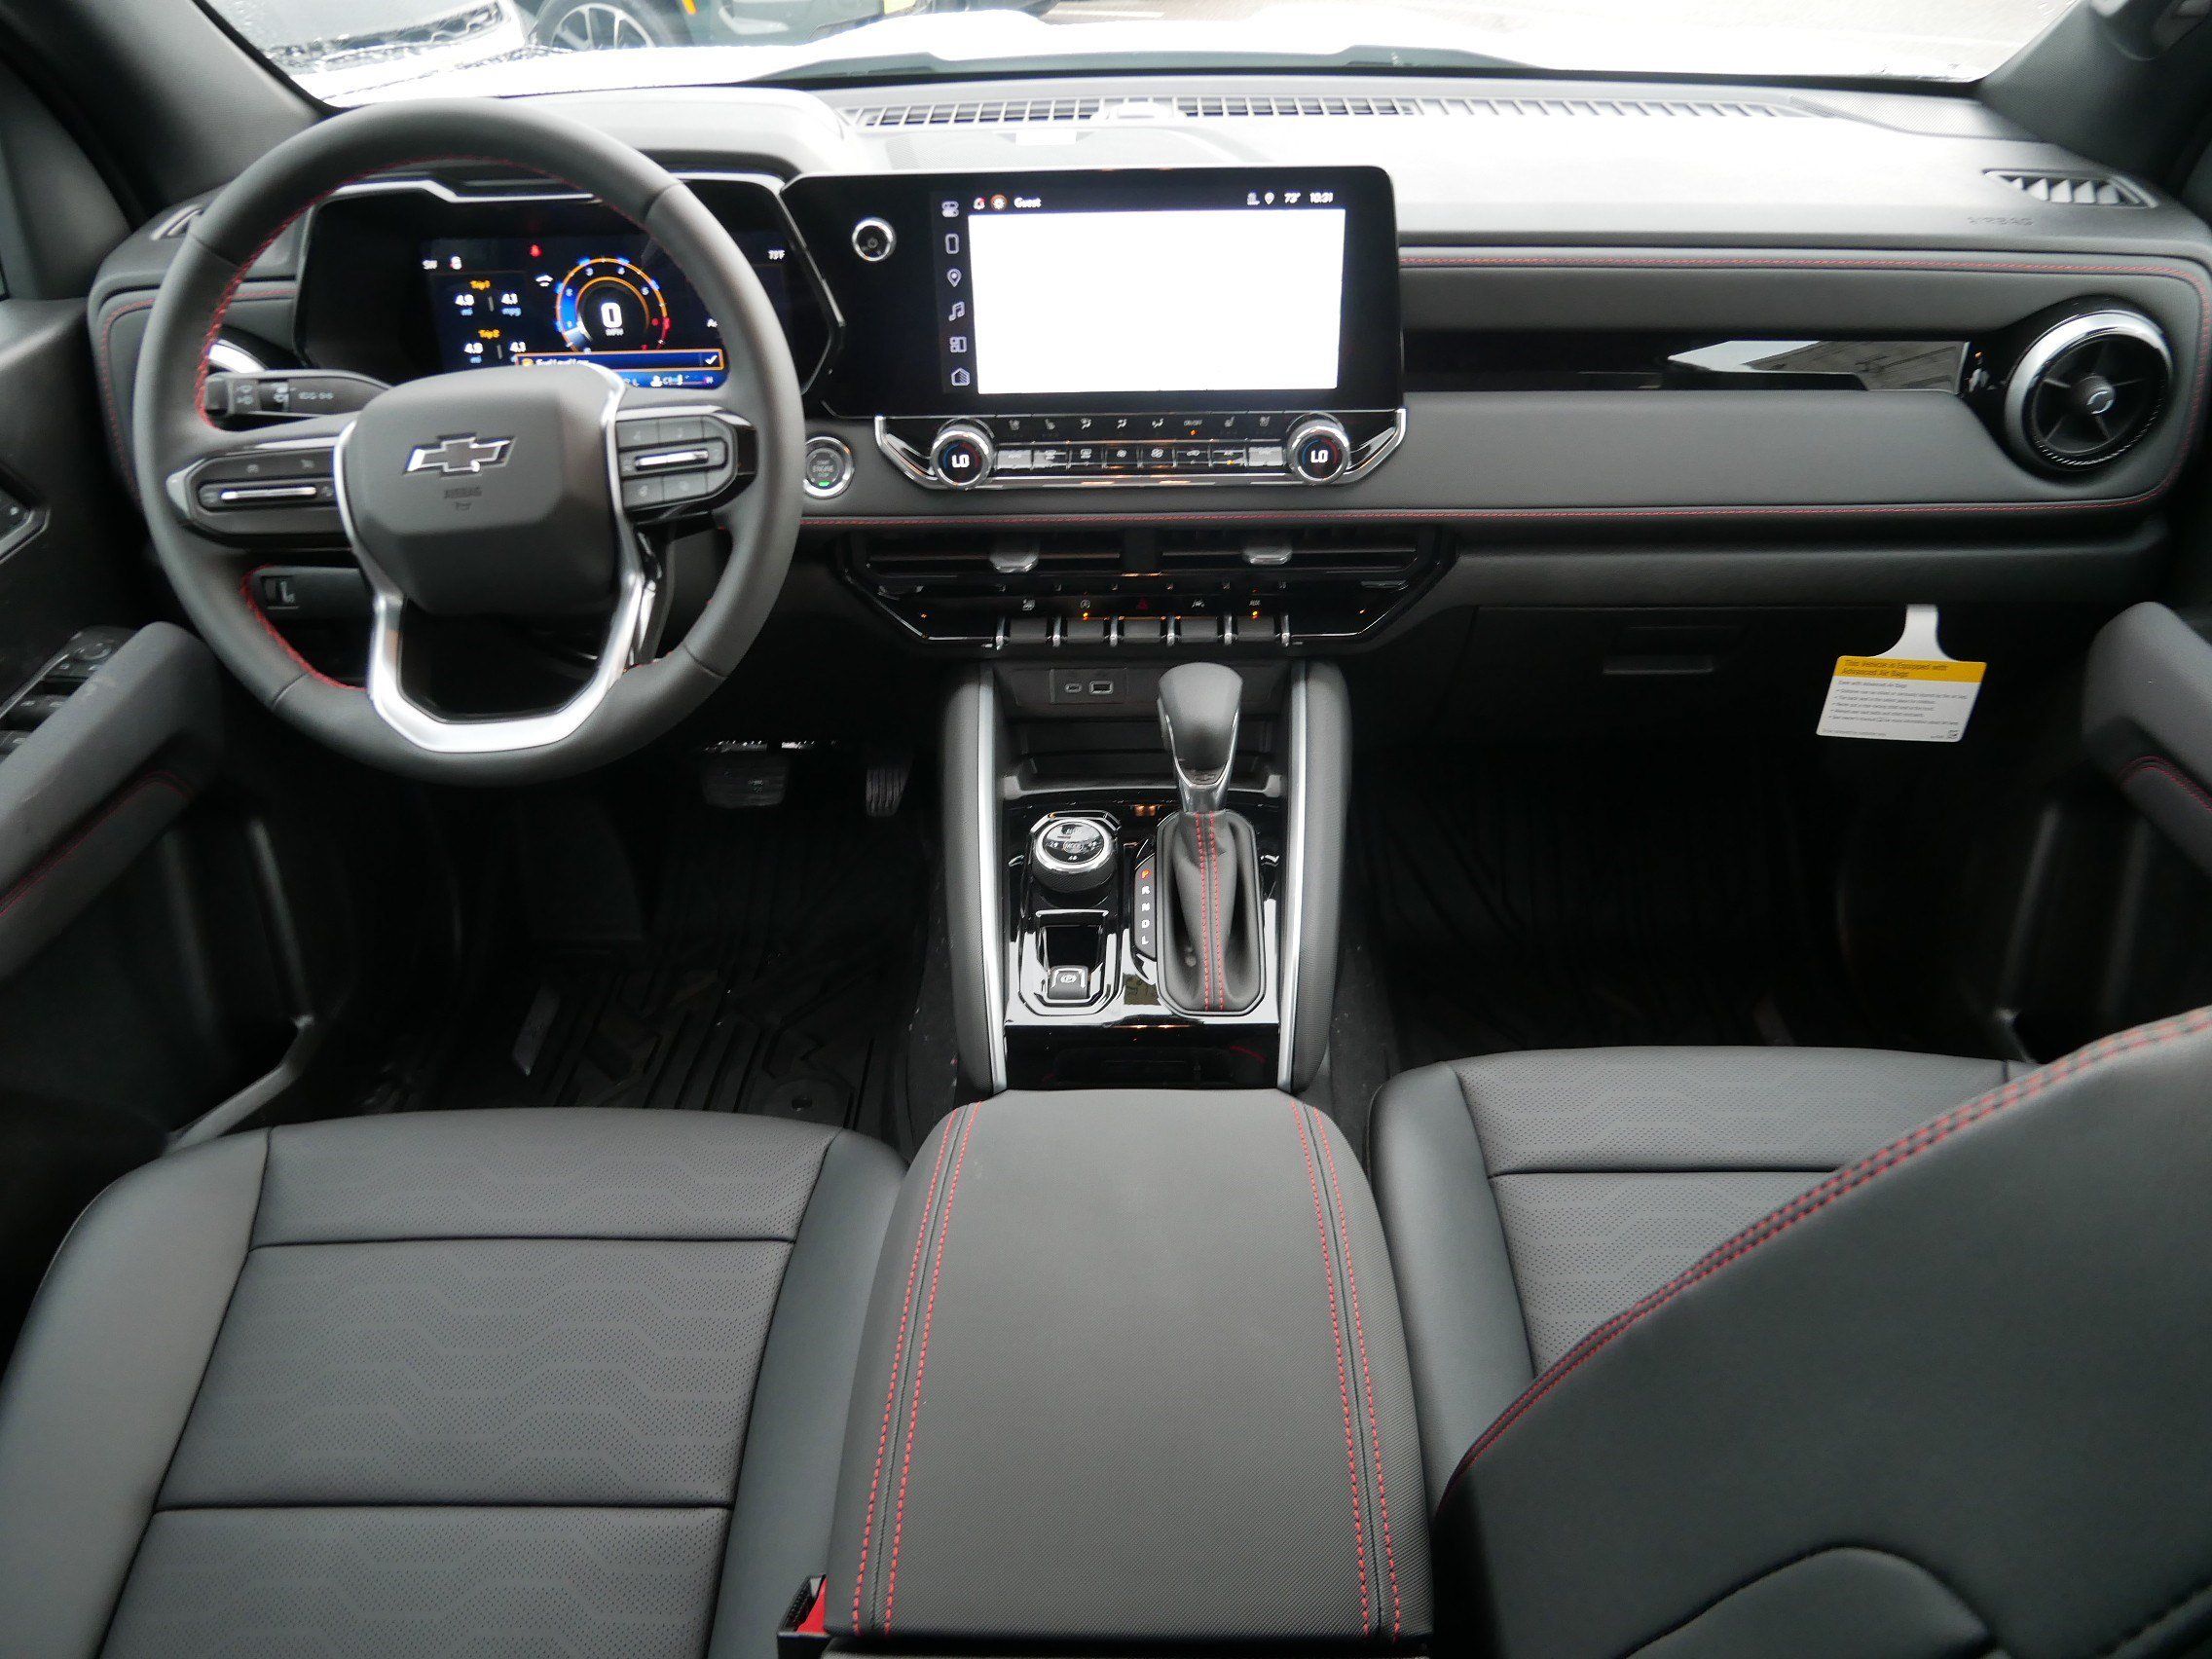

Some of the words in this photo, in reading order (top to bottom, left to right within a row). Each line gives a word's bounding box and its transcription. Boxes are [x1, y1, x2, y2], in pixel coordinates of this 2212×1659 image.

[600, 302, 623, 329] 0
[1141, 885, 1150, 895] R
[1141, 903, 1151, 911] N
[1141, 936, 1149, 945] L
